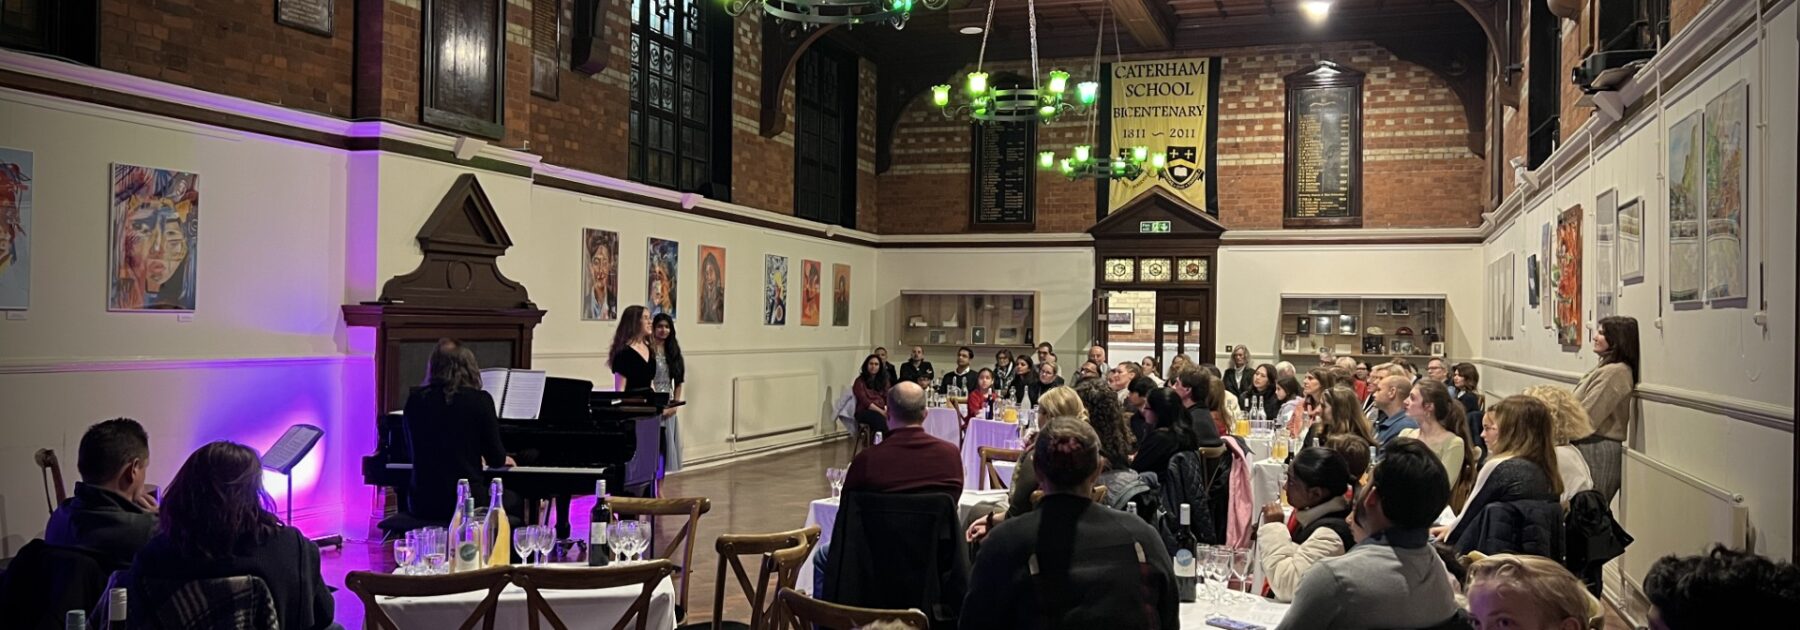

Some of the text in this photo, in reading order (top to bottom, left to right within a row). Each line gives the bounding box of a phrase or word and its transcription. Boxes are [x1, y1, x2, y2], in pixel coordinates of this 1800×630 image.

[1115, 61, 1205, 79] CATERHAM
[1125, 82, 1194, 98] SCHOOL
[1113, 105, 1205, 119] BICENTENARY
[1123, 128, 1146, 138] 1811
[1169, 128, 1195, 138] 2011
